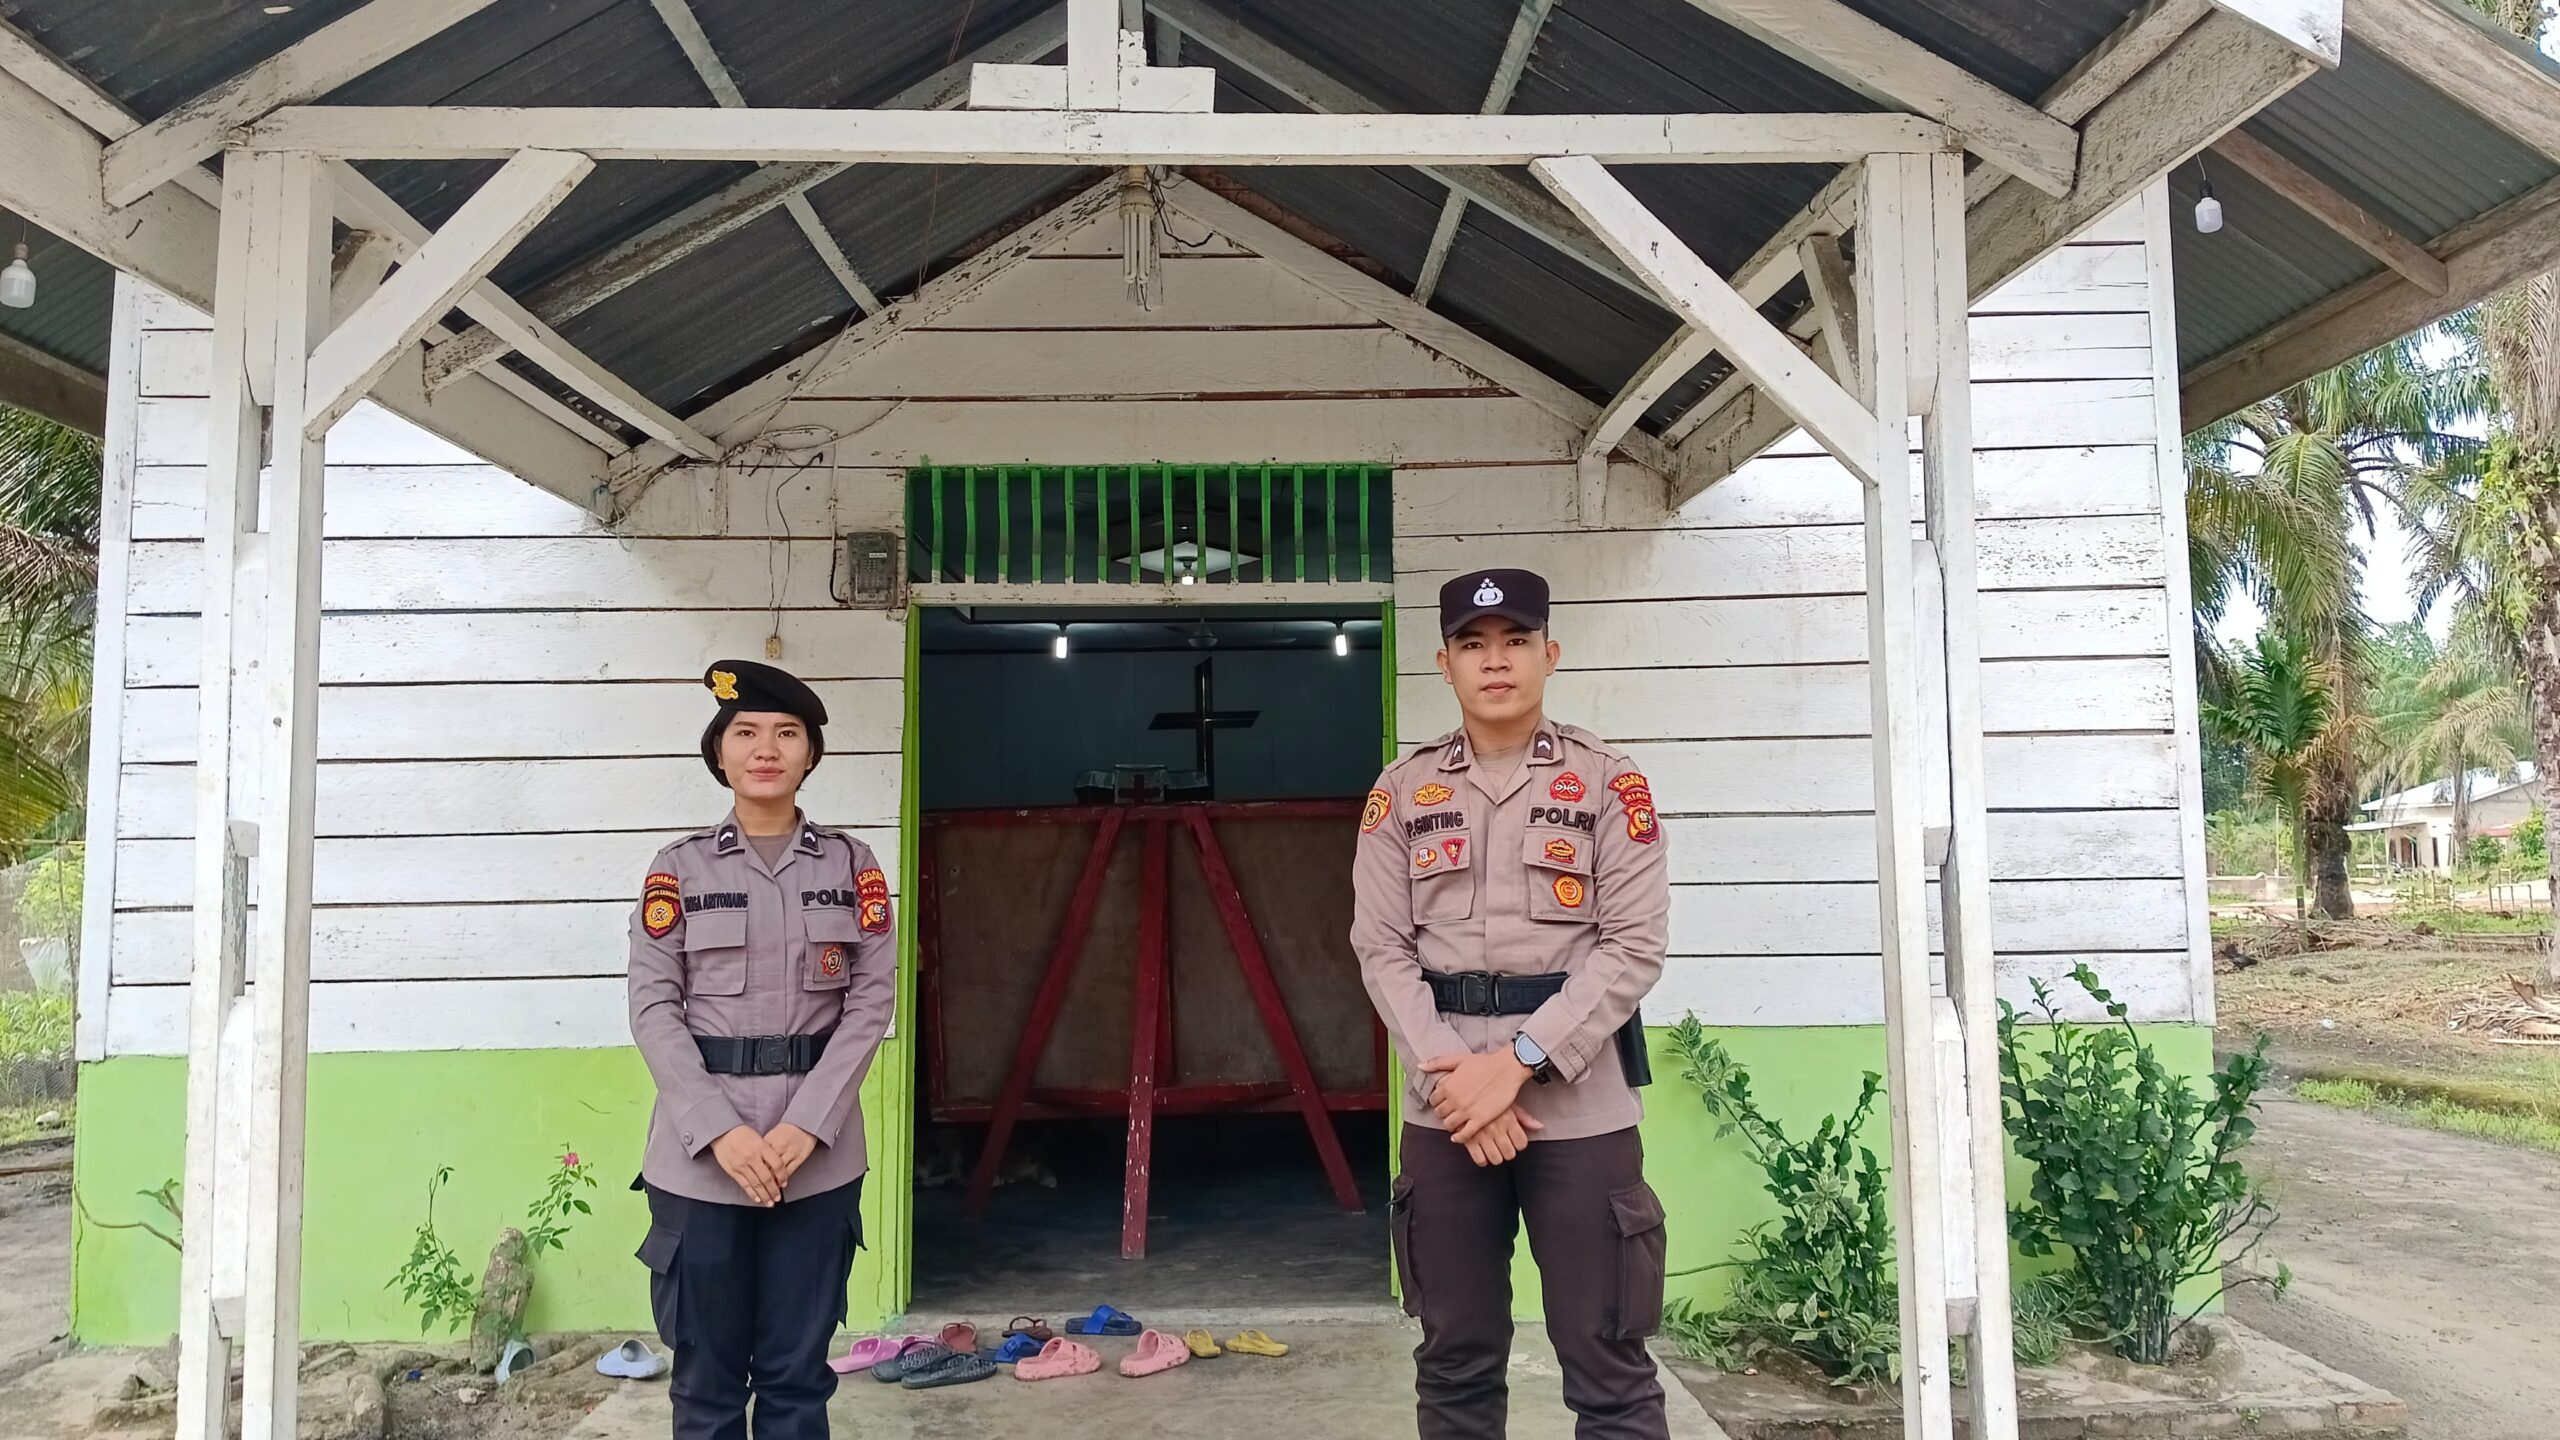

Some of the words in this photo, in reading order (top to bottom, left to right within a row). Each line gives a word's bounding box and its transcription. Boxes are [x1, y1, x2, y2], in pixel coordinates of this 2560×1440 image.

[1624, 792, 1649, 801] RIAU
[1405, 811, 1464, 839] P.GINTING
[1531, 807, 1597, 831] POLRI
[861, 886, 885, 895] RIAU
